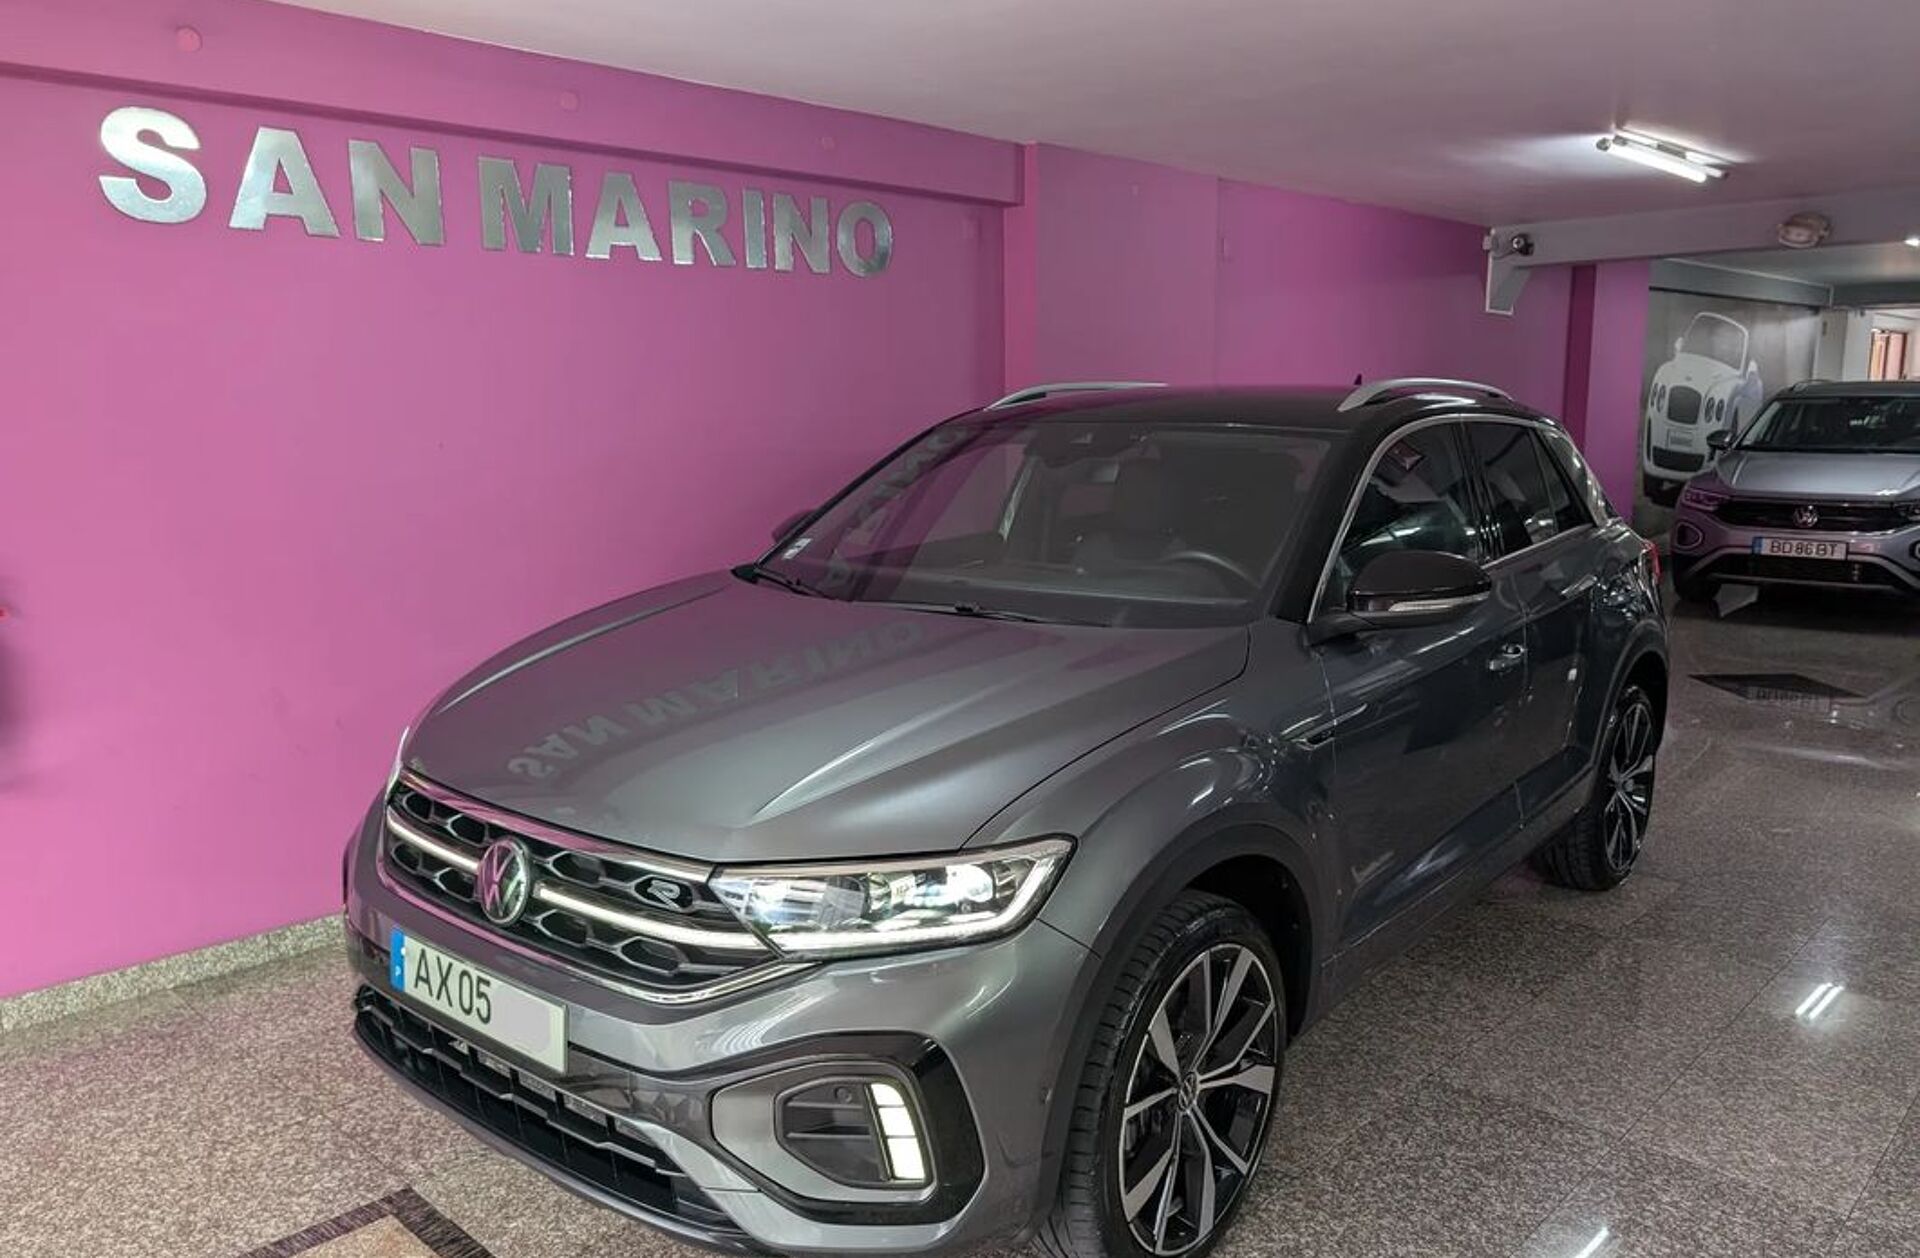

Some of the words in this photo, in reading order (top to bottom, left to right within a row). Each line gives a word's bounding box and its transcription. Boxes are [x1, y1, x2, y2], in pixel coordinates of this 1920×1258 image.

[98, 106, 446, 247] SAN
[478, 155, 895, 278] MARINO
[413, 948, 455, 1007] AX
[457, 969, 492, 1025] 05
